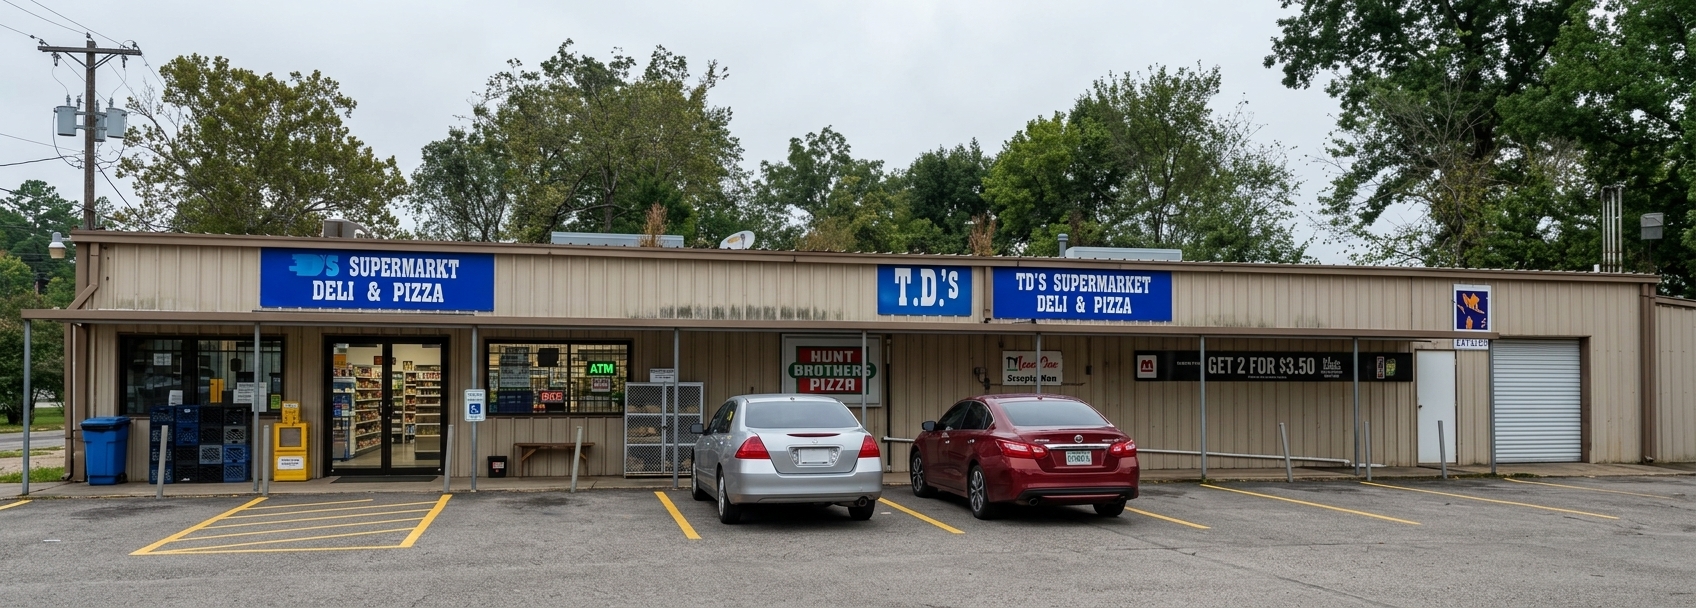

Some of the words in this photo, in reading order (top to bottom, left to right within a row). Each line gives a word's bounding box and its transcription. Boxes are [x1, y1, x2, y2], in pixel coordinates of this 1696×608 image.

[349, 256, 460, 279] SUPERMARKT
[312, 280, 354, 301] DELI
[367, 281, 381, 302] &
[393, 282, 444, 303] PIZZA
[1015, 272, 1047, 291] TD'S
[1053, 273, 1151, 294] SUPERMARKET
[1037, 295, 1067, 313] DELI
[1076, 296, 1086, 313] &
[1094, 296, 1132, 315] PIZZA
[811, 350, 854, 363] HUNT
[1208, 356, 1234, 374] GET
[1237, 356, 1246, 375] 2
[1249, 357, 1275, 375] FOR
[1279, 356, 1315, 375] $3.50
[590, 363, 614, 374] ATM
[810, 378, 855, 391] PIZZA
